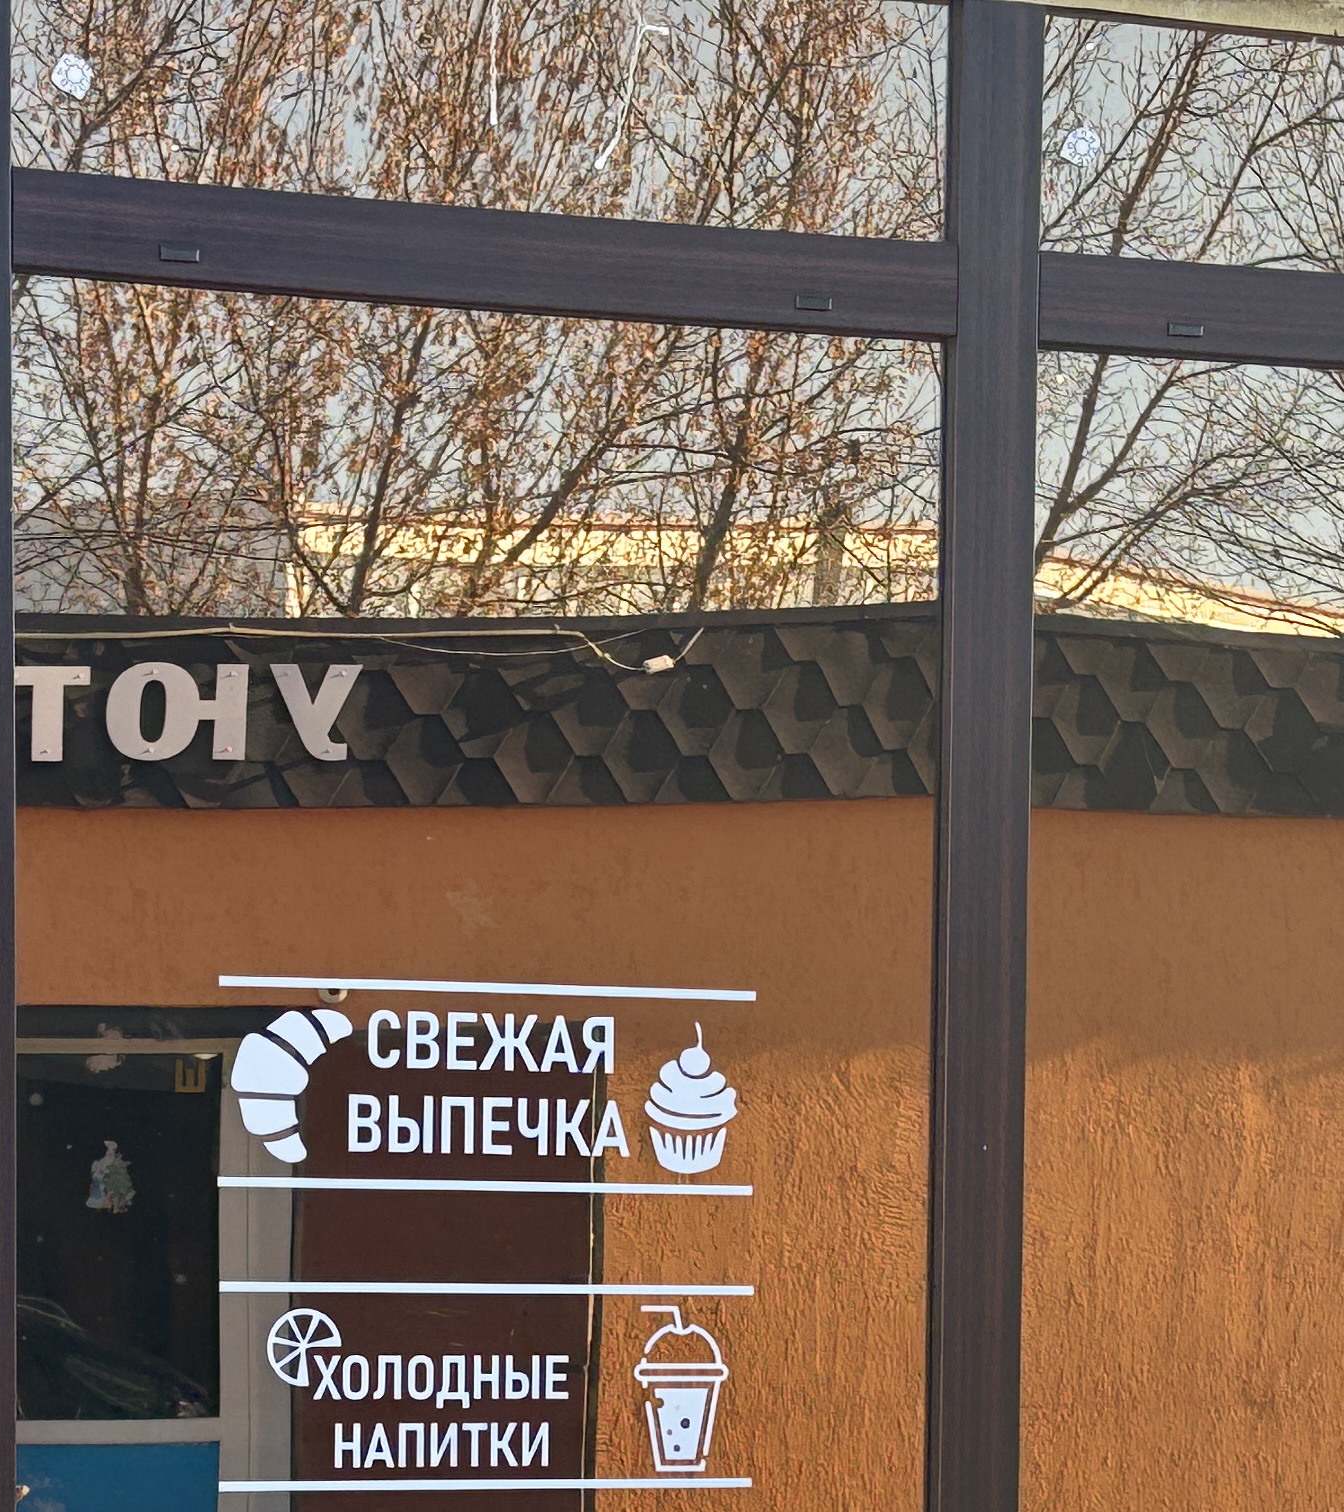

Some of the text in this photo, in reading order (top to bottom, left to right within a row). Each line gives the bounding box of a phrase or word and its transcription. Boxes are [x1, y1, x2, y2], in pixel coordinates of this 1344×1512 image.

[367, 1009, 615, 1074] СВЕЖАЯ
[348, 1093, 631, 1158] ВЫПЕЧКА
[313, 1354, 570, 1409] ХОЛОДНЫЕ
[334, 1421, 550, 1469] НАПИТКИ
